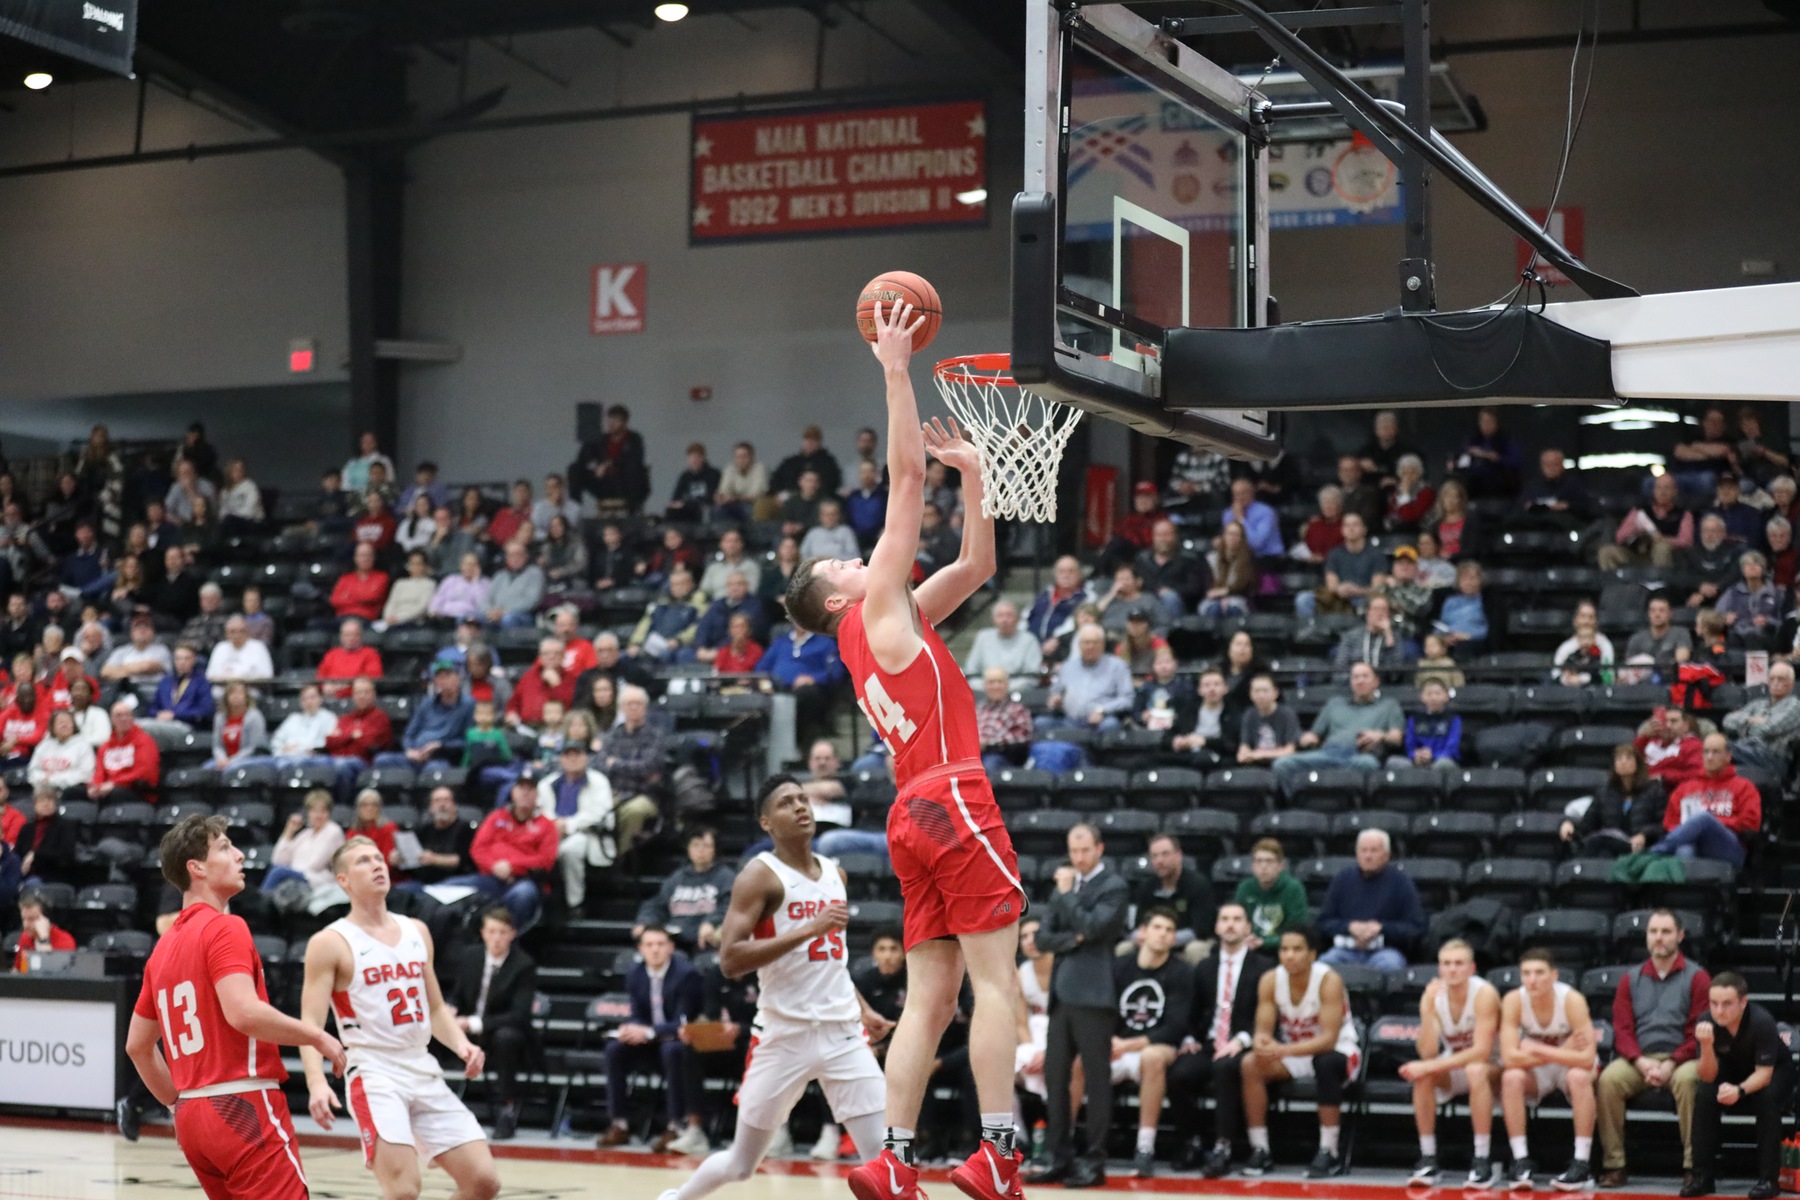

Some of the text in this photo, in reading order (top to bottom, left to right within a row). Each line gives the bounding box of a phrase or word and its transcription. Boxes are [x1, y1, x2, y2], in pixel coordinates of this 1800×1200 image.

[755, 117, 923, 154] NAIA NATIONAL
[703, 146, 977, 193] BASKETBALL CHAMPIONS
[729, 194, 780, 226] 1992
[852, 186, 930, 216] DIVISION
[597, 266, 637, 317] K
[788, 899, 847, 920] GRA
[808, 927, 844, 962] 25
[363, 961, 425, 986] GRAC
[157, 980, 205, 1061] 13
[387, 986, 424, 1026] 23
